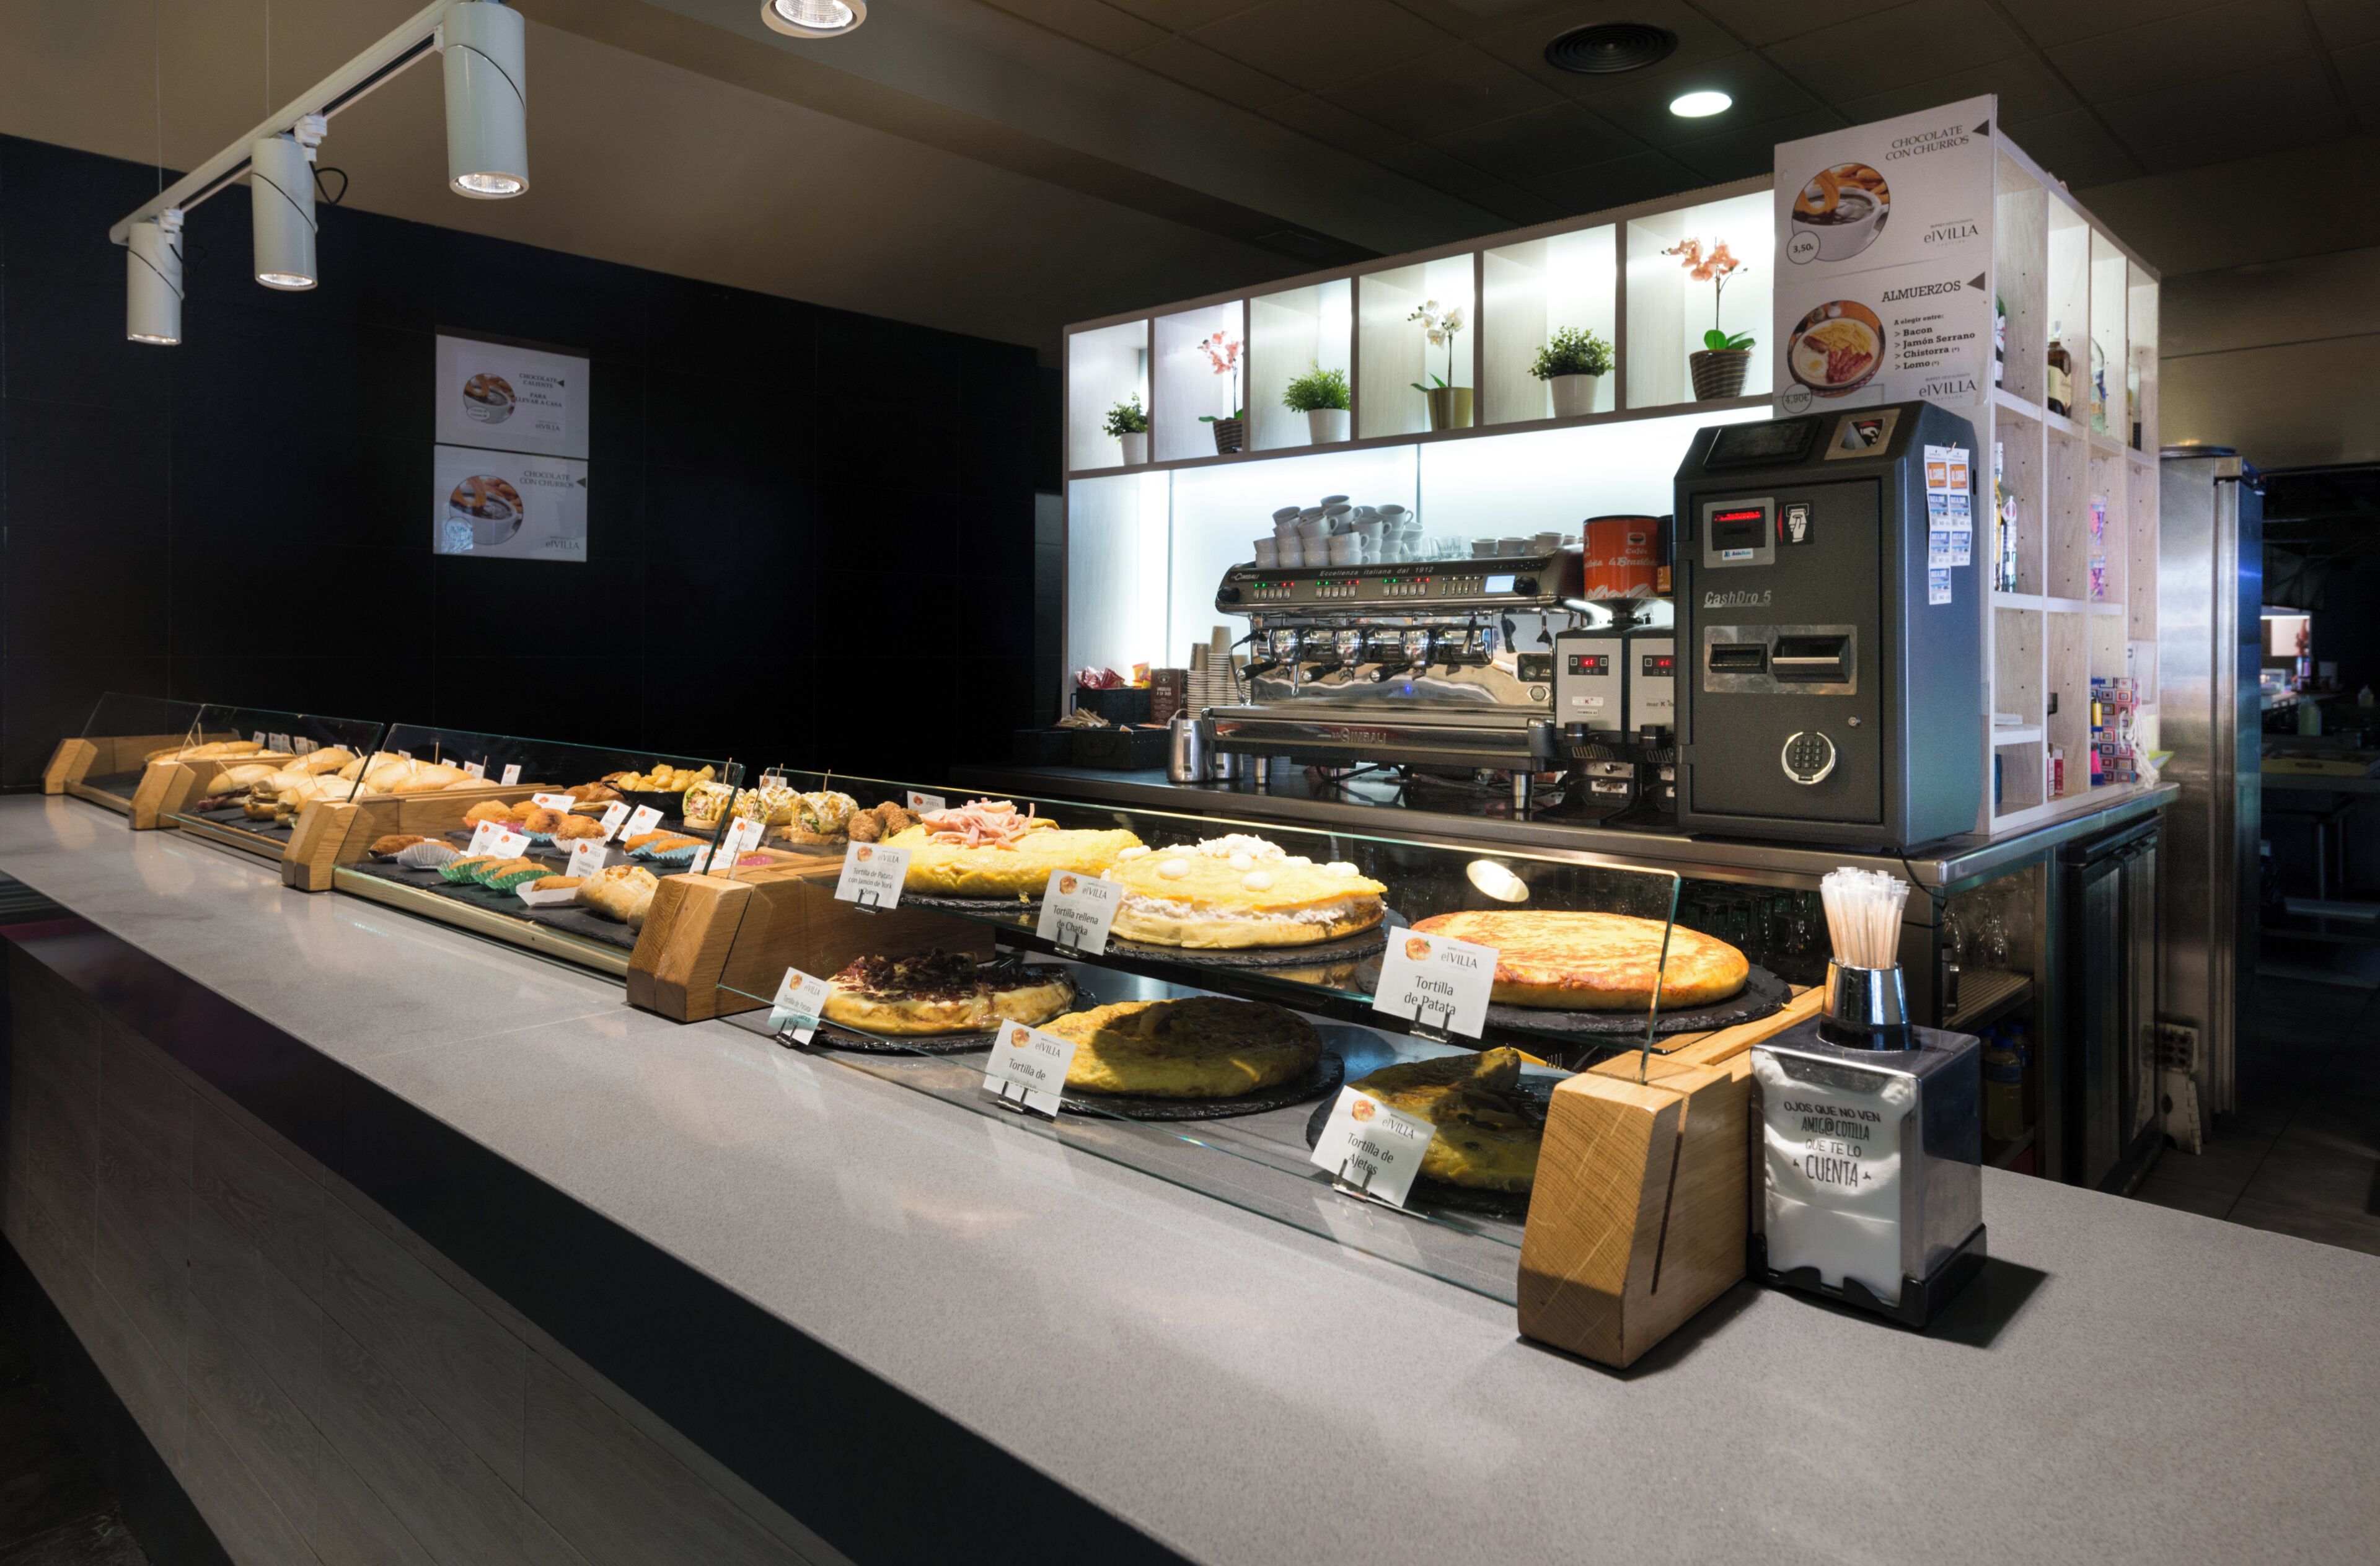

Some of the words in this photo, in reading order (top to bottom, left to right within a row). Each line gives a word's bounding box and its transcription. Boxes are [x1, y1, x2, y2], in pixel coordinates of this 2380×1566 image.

[1892, 125, 1963, 149] CHOCOLATE
[1885, 148, 1911, 161] CON
[1913, 135, 1969, 155] CHURROS
[1882, 280, 1961, 302] ALMUERZOS
[1903, 327, 1933, 337] Bacon
[1903, 337, 1934, 350] Jamón
[1936, 333, 1976, 343] Serrano
[1903, 347, 1950, 359] Chistorra
[1903, 361, 1930, 370] Lomo
[519, 373, 557, 383] CHOCOLATE
[523, 380, 553, 389] CALIENTE
[524, 470, 570, 481] CHOCOLATE
[538, 480, 575, 489] CHURROS
[1320, 569, 1359, 577] Eccellenza
[1705, 591, 1758, 605] CashDro
[853, 868, 870, 876] Tortilla
[878, 871, 893, 880] Patata
[858, 878, 873, 886] Jamón
[1054, 905, 1075, 918] Tortilla
[1075, 912, 1099, 925] rellena
[1057, 919, 1065, 929] de
[1066, 922, 1088, 936] Chatka
[1415, 975, 1453, 996] Tortilla
[1404, 992, 1418, 1005] de
[1421, 995, 1456, 1015] Patata
[1008, 1057, 1034, 1076] Tortilla
[1035, 1069, 1046, 1081] de
[1784, 1101, 1813, 1113] OJOS
[1815, 1104, 1838, 1116] QUE
[1839, 1108, 1856, 1118] NO
[1858, 1110, 1881, 1123] VEN
[1801, 1116, 1835, 1136] AMIG@
[1835, 1120, 1870, 1141] COTILLA
[1347, 1132, 1380, 1157] Tortilla
[1381, 1150, 1394, 1164] de
[1805, 1138, 1826, 1152] QUE
[1830, 1141, 1844, 1155] TE
[1847, 1145, 1862, 1158] LO
[1348, 1153, 1378, 1176] Ajetes
[1806, 1155, 1858, 1187] CUENTA
